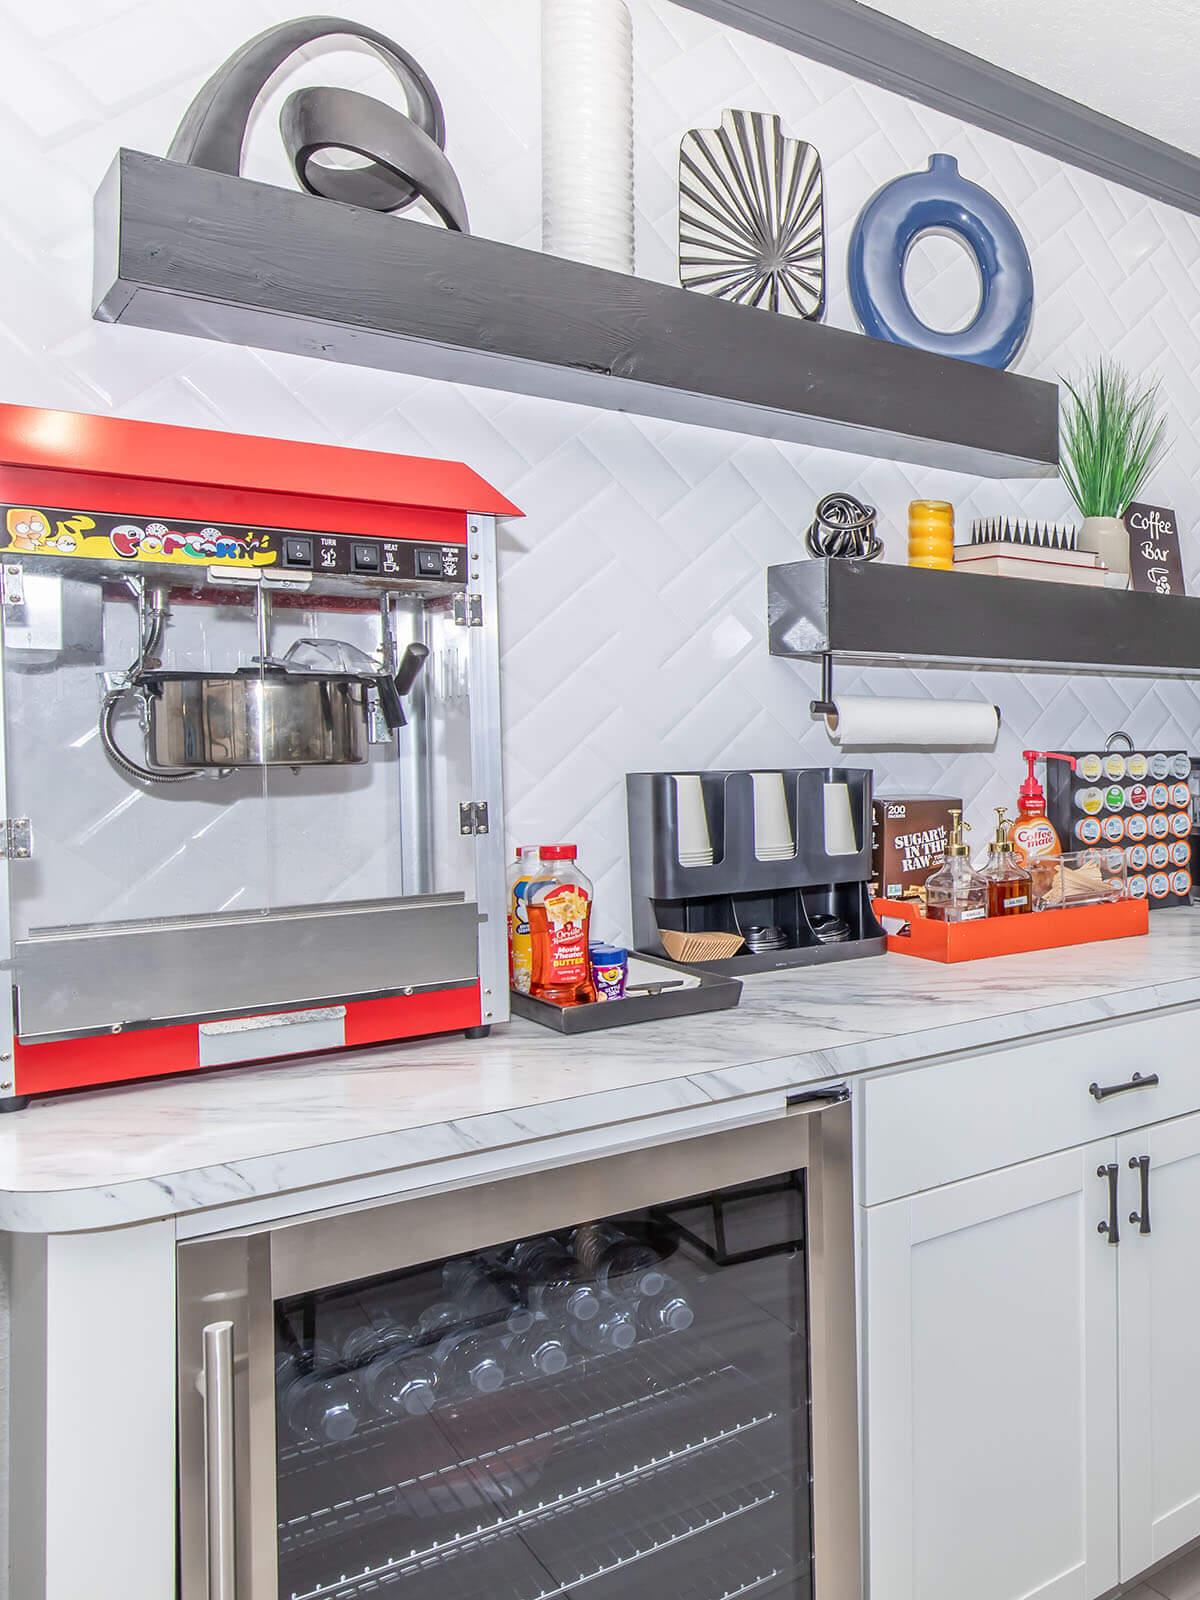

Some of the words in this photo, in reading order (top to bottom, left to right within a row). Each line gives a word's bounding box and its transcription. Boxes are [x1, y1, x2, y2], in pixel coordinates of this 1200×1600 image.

[1130, 511, 1174, 540] Coffee
[320, 537, 337, 547] TURN
[383, 543, 399, 551] HEAT
[1140, 541, 1170, 562] Bar
[888, 805, 906, 814] 200
[894, 827, 943, 849] SUGAR
[1017, 830, 1052, 843] Coffee
[1027, 836, 1053, 848] mate
[904, 845, 920, 859] IN
[902, 855, 931, 872] RAW
[553, 951, 584, 960] Theater
[558, 945, 581, 954] Movie
[553, 958, 585, 968] BUTTER
